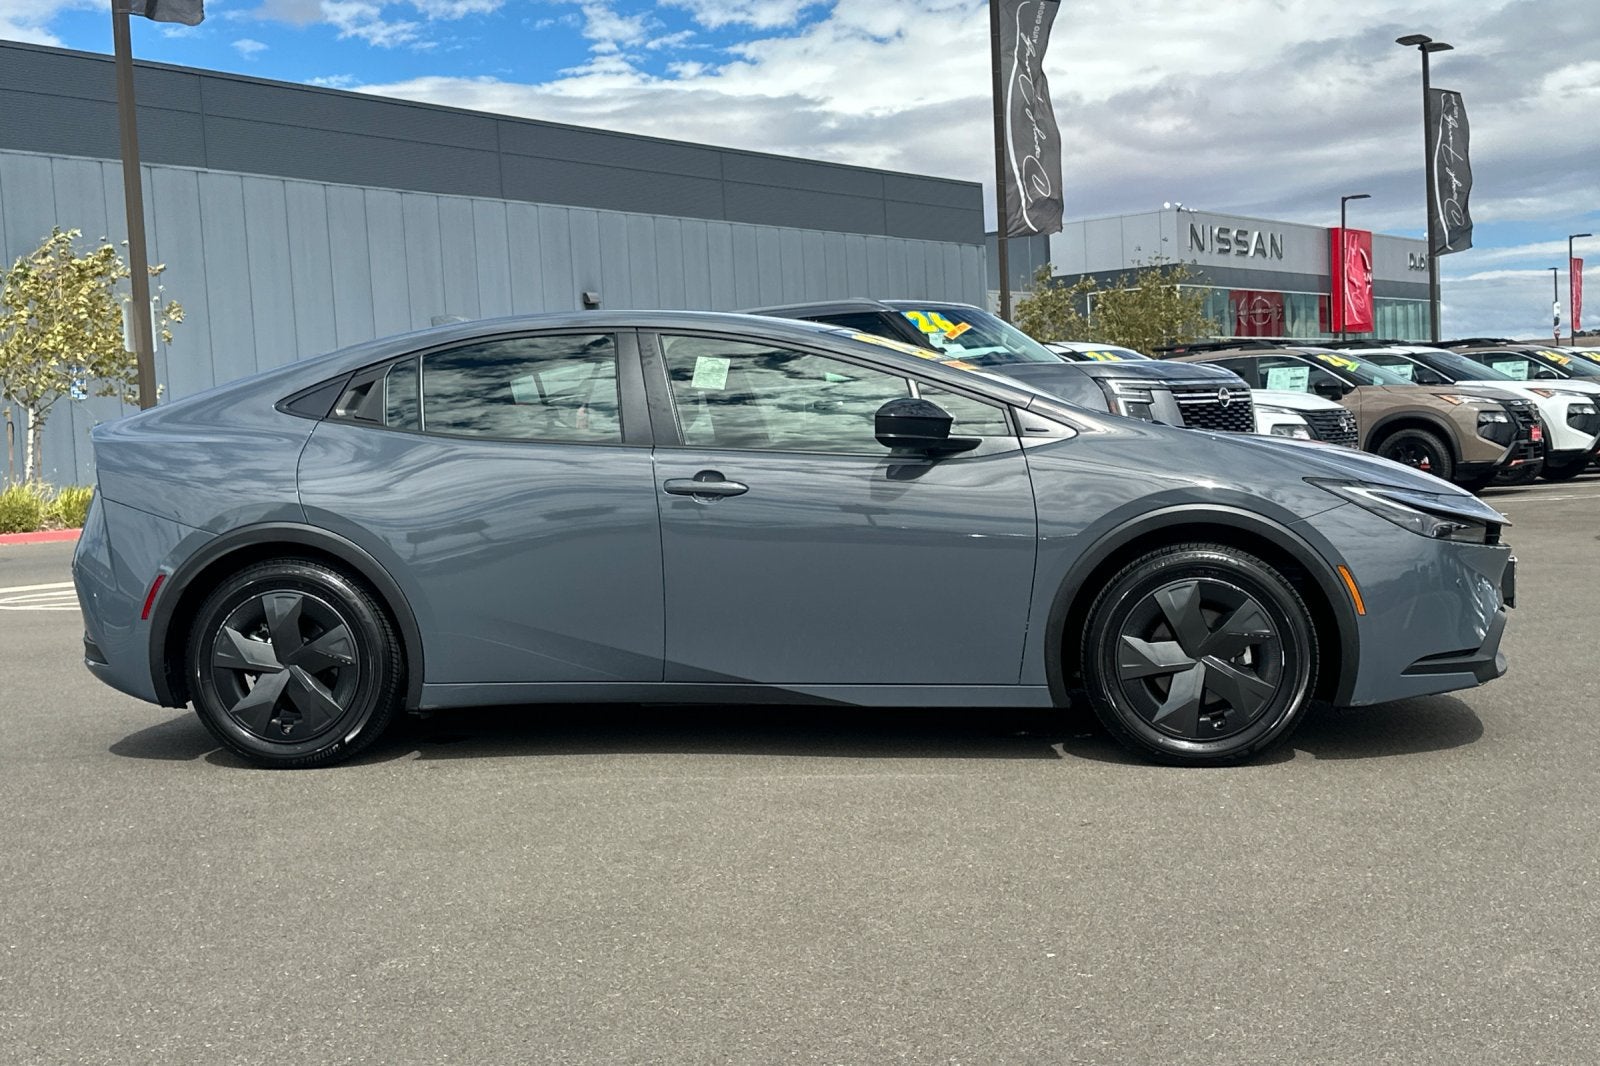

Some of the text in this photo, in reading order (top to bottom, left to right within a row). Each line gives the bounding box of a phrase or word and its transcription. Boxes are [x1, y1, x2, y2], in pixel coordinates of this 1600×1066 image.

[1032, 1, 1046, 44] AUTO GROUP
[1188, 223, 1283, 260] NISSAN
